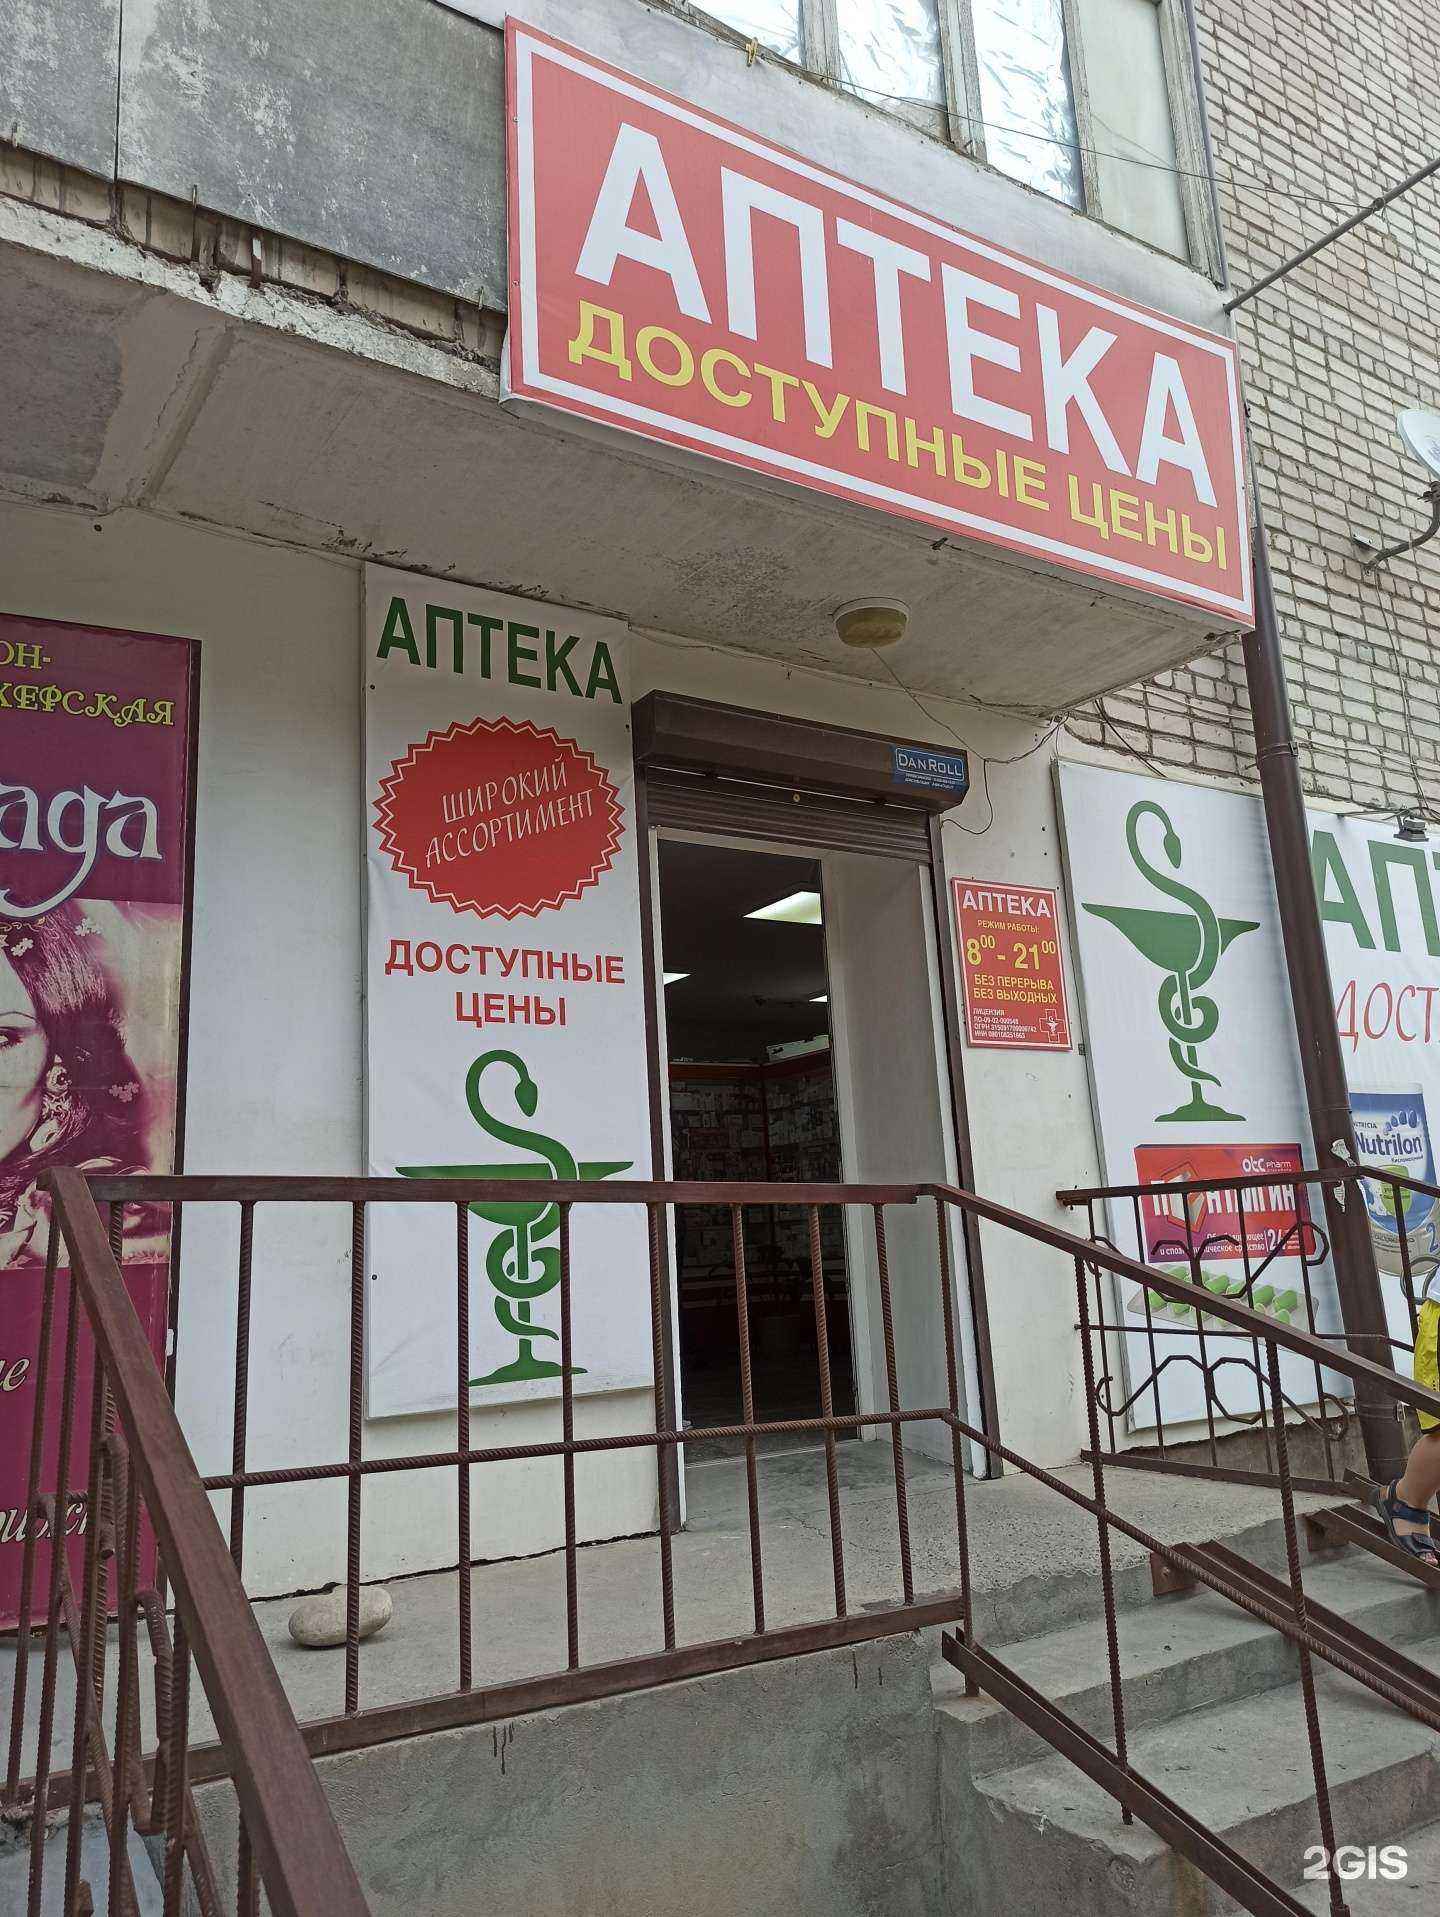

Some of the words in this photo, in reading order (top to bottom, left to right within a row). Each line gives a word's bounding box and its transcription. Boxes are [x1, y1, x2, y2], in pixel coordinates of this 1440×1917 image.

[575, 122, 1217, 507] АПТЕКА
[568, 301, 1049, 511] ДОСТУПНЫЕ
[1068, 474, 1227, 570] ЦЕНЫ
[376, 597, 622, 704] АПТЕКА
[442, 753, 567, 823] ШИРОКИЙ
[425, 789, 593, 868] АССОРТИМЕНТ
[963, 890, 1051, 917] АПТЕКА
[1311, 829, 1440, 957] АП
[977, 920, 1005, 930] РЕЖИМ
[384, 939, 625, 985] ДОСТУПНЫЕ
[974, 974, 995, 986] БЕЗ
[997, 976, 1054, 991] ПЕРЕРЫВА
[455, 992, 567, 1028] ЦЕНЫ
[973, 988, 994, 999] БЕЗ
[997, 989, 1058, 1004] ВЫХОДНЫХ
[1355, 1132, 1422, 1155] Nutrilon
